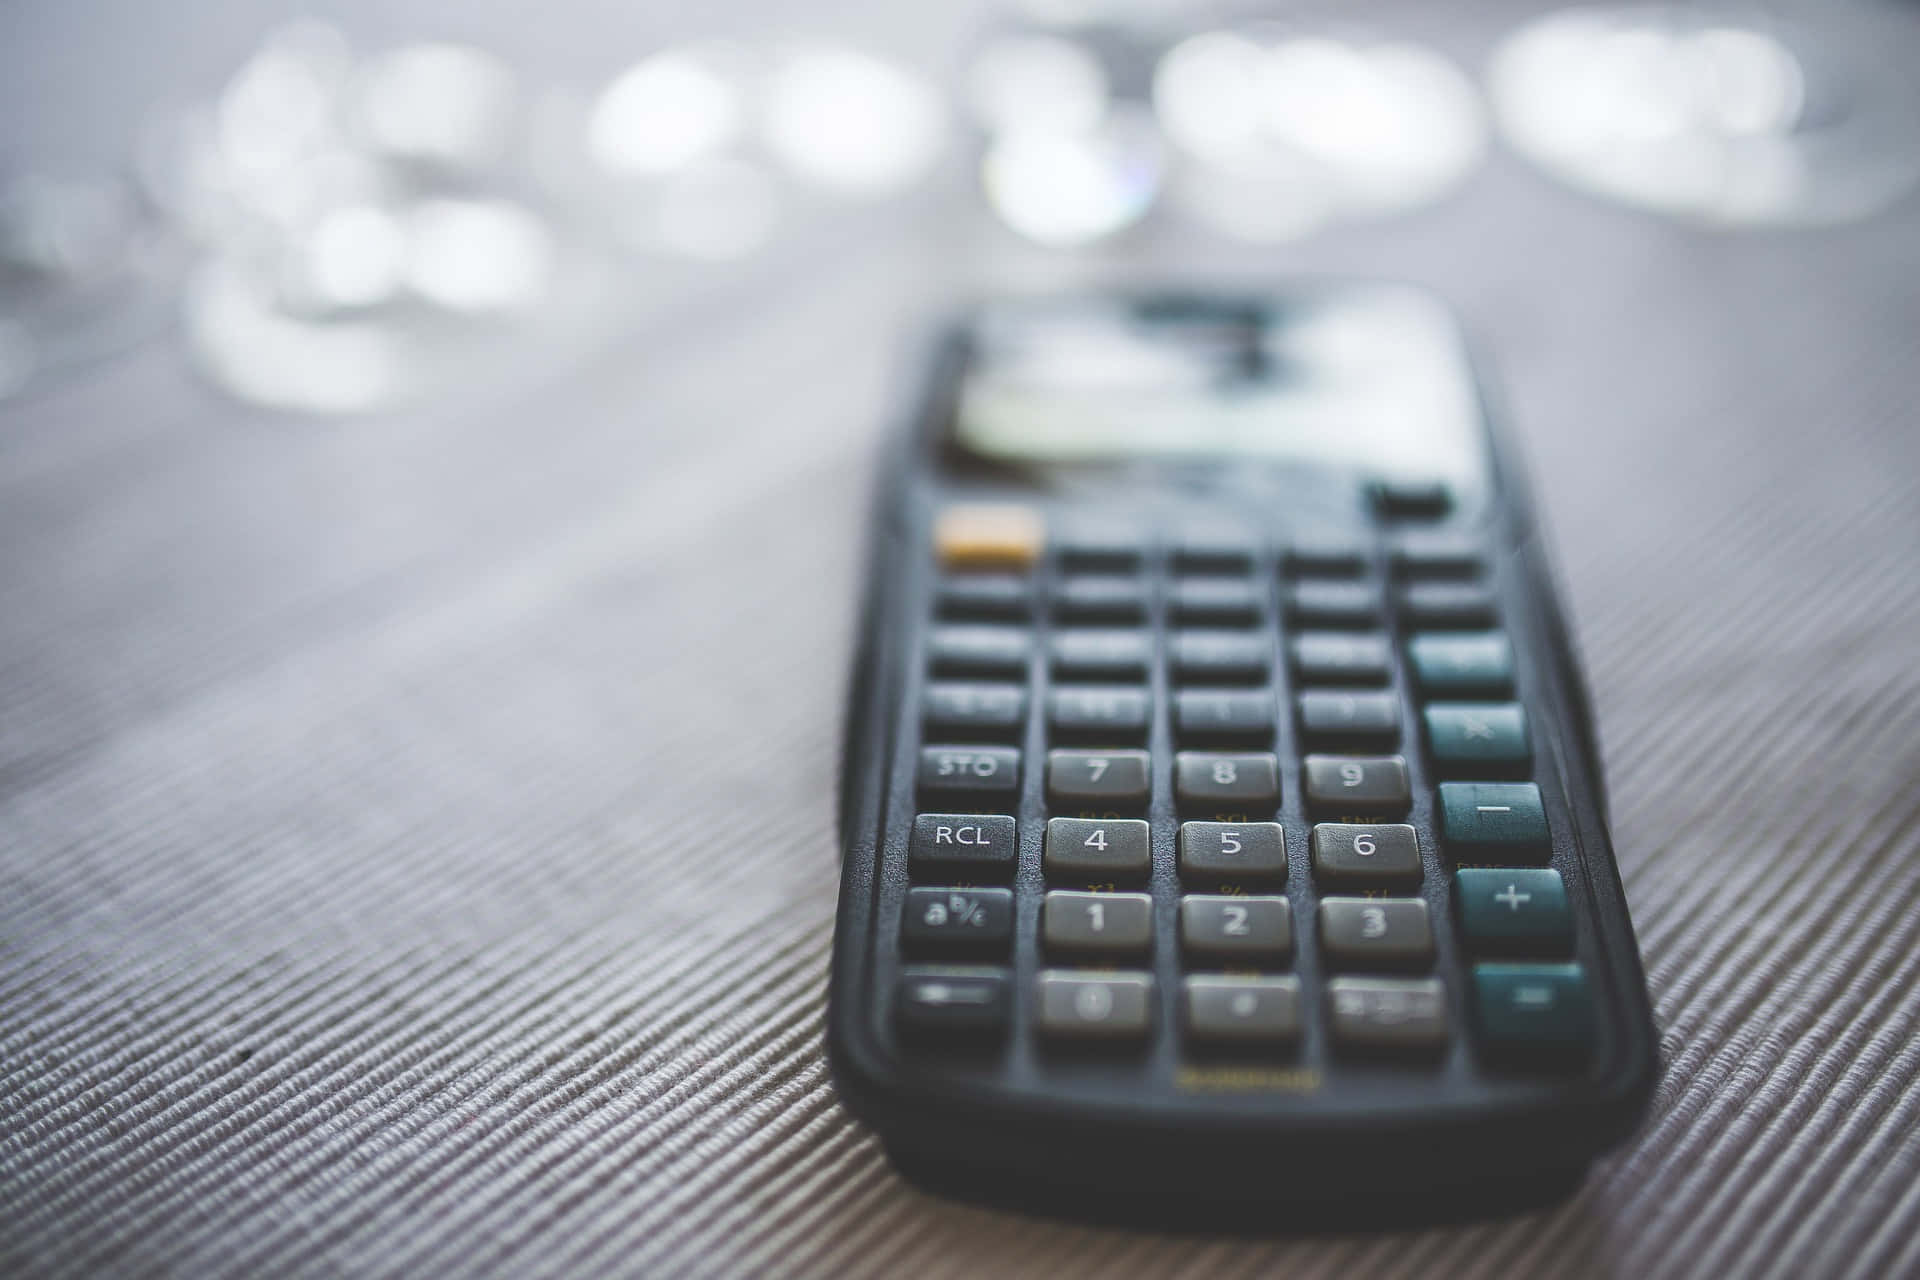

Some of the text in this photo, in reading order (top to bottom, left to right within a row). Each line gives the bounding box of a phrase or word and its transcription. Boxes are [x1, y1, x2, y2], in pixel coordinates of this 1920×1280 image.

[938, 755, 998, 777] STO
[1087, 758, 1110, 782] 7
[1212, 760, 1237, 785] 8
[1341, 763, 1364, 787] 9
[936, 826, 991, 845] RCL
[1084, 829, 1109, 851] 4
[1220, 832, 1242, 854] 5
[1353, 834, 1376, 856] 6
[1087, 903, 1105, 931] 1
[1222, 906, 1248, 935] 2
[1361, 908, 1387, 938] 3
